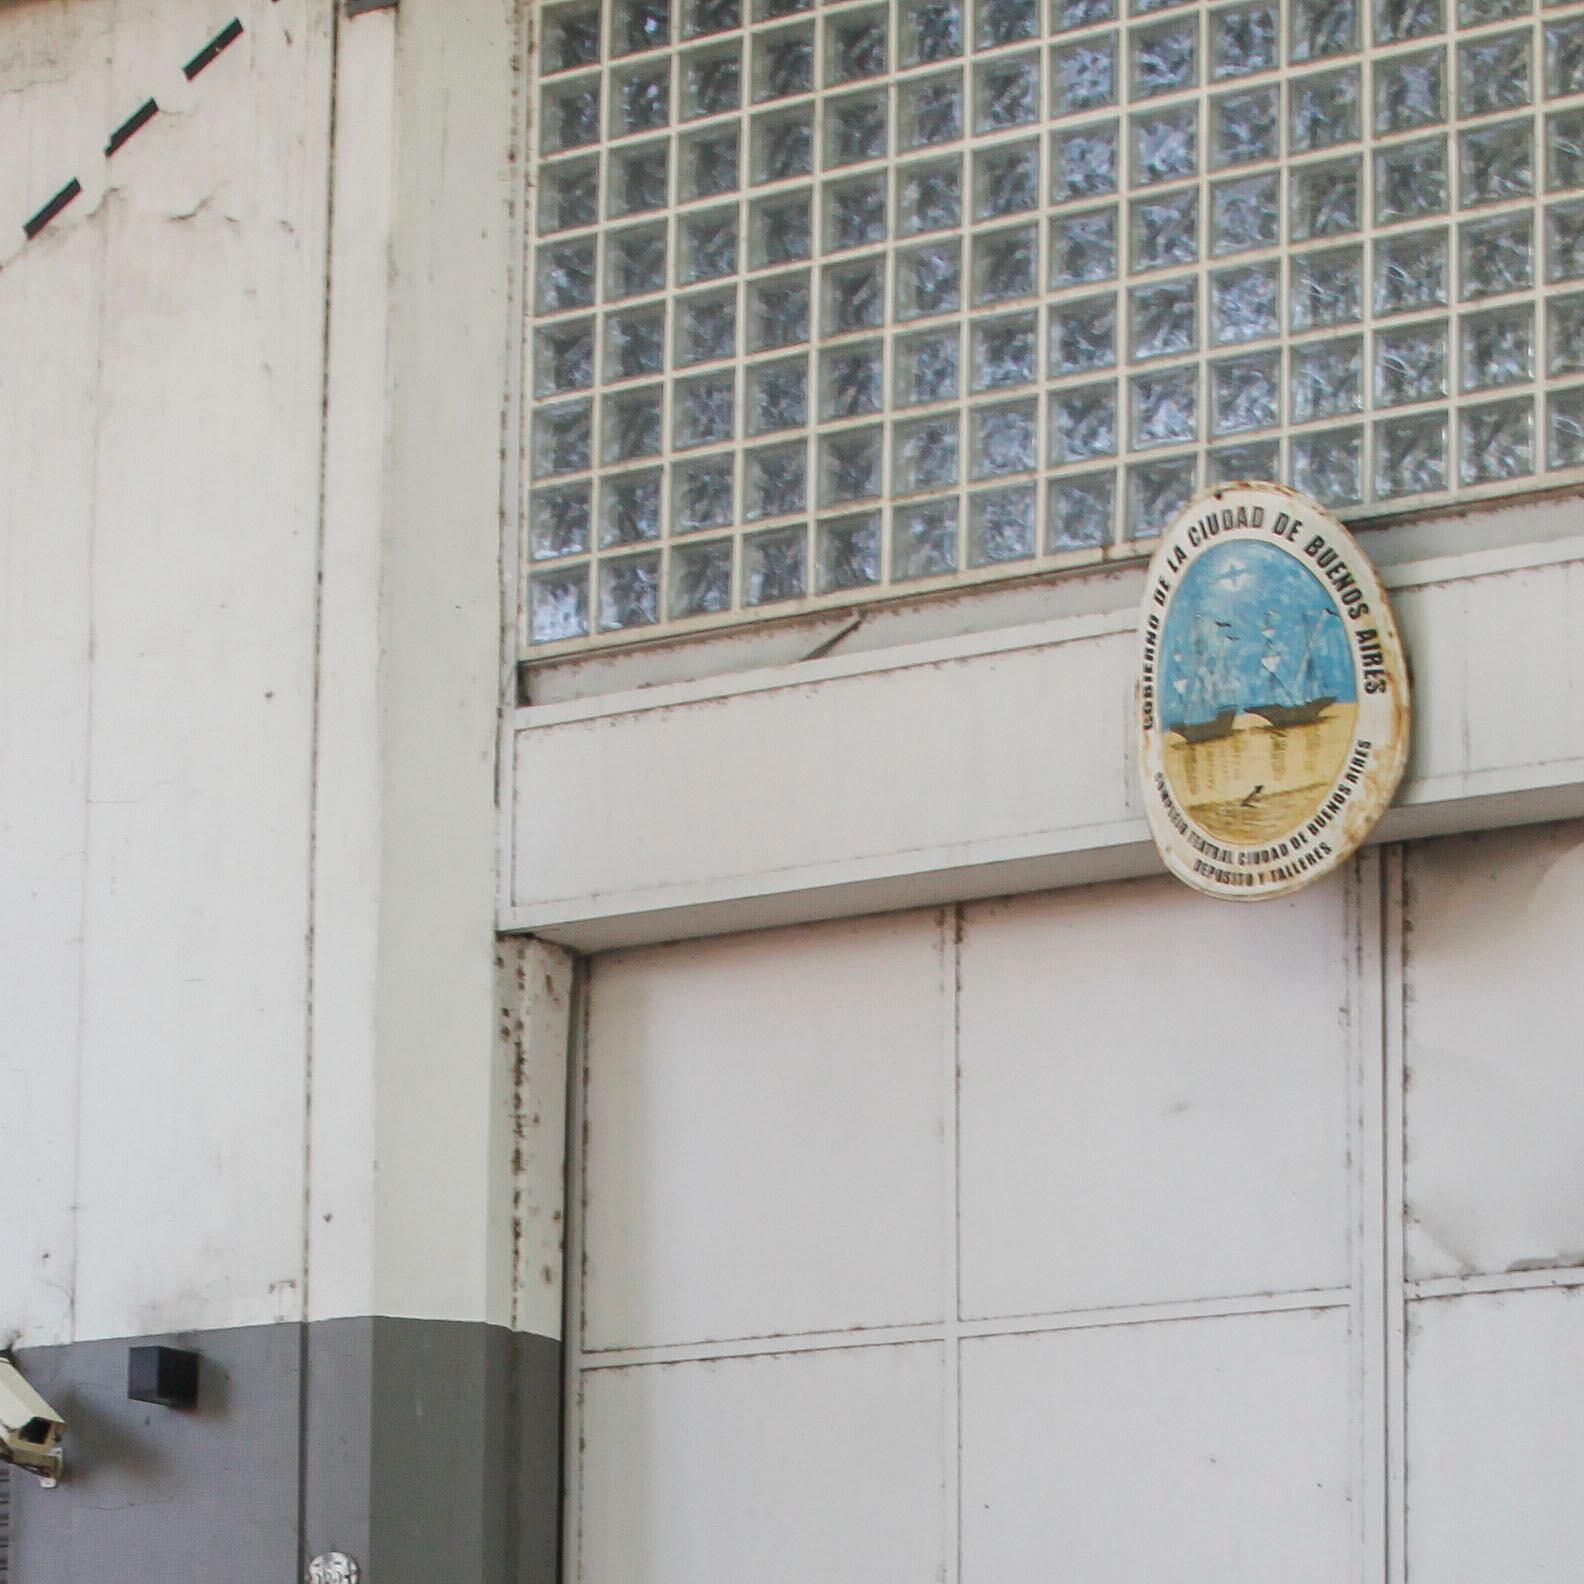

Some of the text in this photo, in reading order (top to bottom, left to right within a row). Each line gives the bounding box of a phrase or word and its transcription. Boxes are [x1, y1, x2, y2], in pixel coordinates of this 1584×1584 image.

[1153, 574, 1170, 607] DE
[1167, 544, 1188, 573] LA
[1187, 505, 1265, 548] CIUDAD
[1272, 511, 1303, 542] DE
[1304, 534, 1369, 620] BUENOS
[1355, 628, 1386, 695] AIRES
[1289, 832, 1309, 851] DE
[1306, 784, 1352, 837] BUENOS
[1345, 739, 1372, 785] AIRES
[1256, 872, 1265, 886] Y
[1270, 841, 1332, 883] TALLERES
